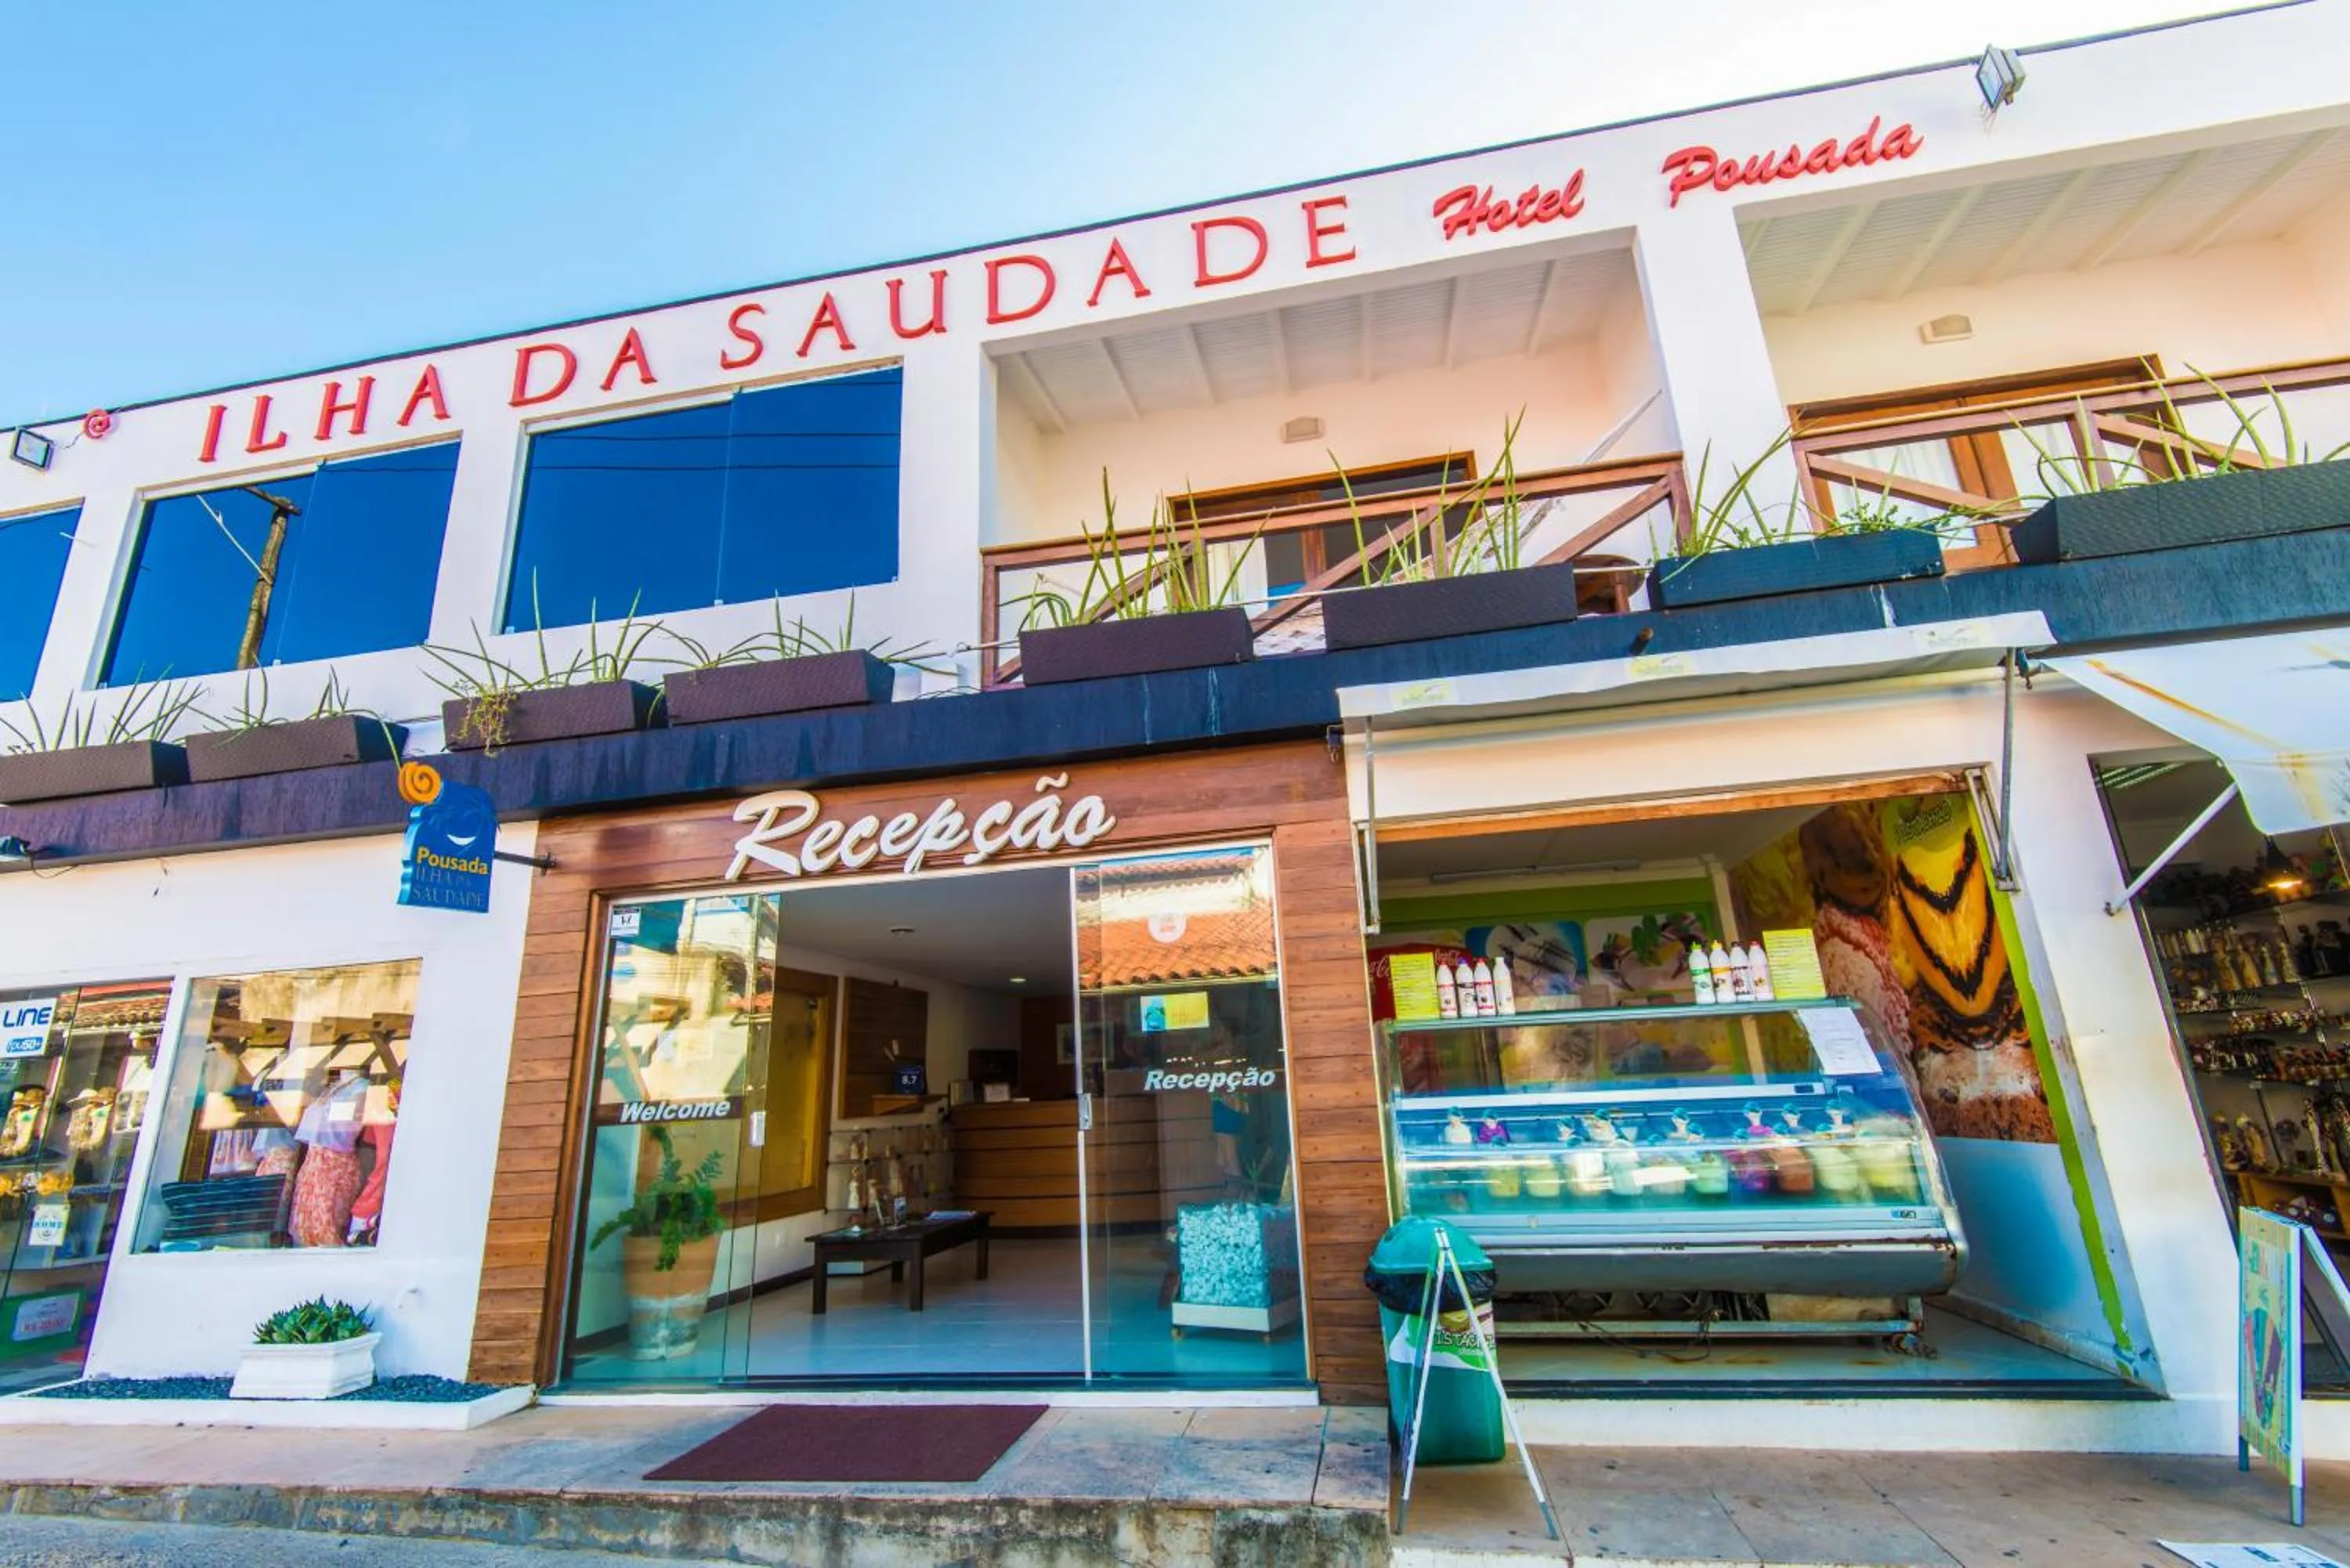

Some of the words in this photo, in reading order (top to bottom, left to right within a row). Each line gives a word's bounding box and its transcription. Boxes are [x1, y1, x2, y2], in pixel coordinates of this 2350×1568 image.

[1432, 168, 1585, 240] Hotel
[1661, 115, 1924, 208] Pousada
[198, 363, 451, 464] ILHA
[509, 327, 657, 408] DA
[720, 195, 1357, 371] SAUDADE
[725, 771, 1117, 880] Recepção
[416, 846, 489, 875] Pousada
[2, 1006, 52, 1028] LINE
[1144, 1067, 1276, 1093] Recepção
[620, 1100, 731, 1123] Welcome
